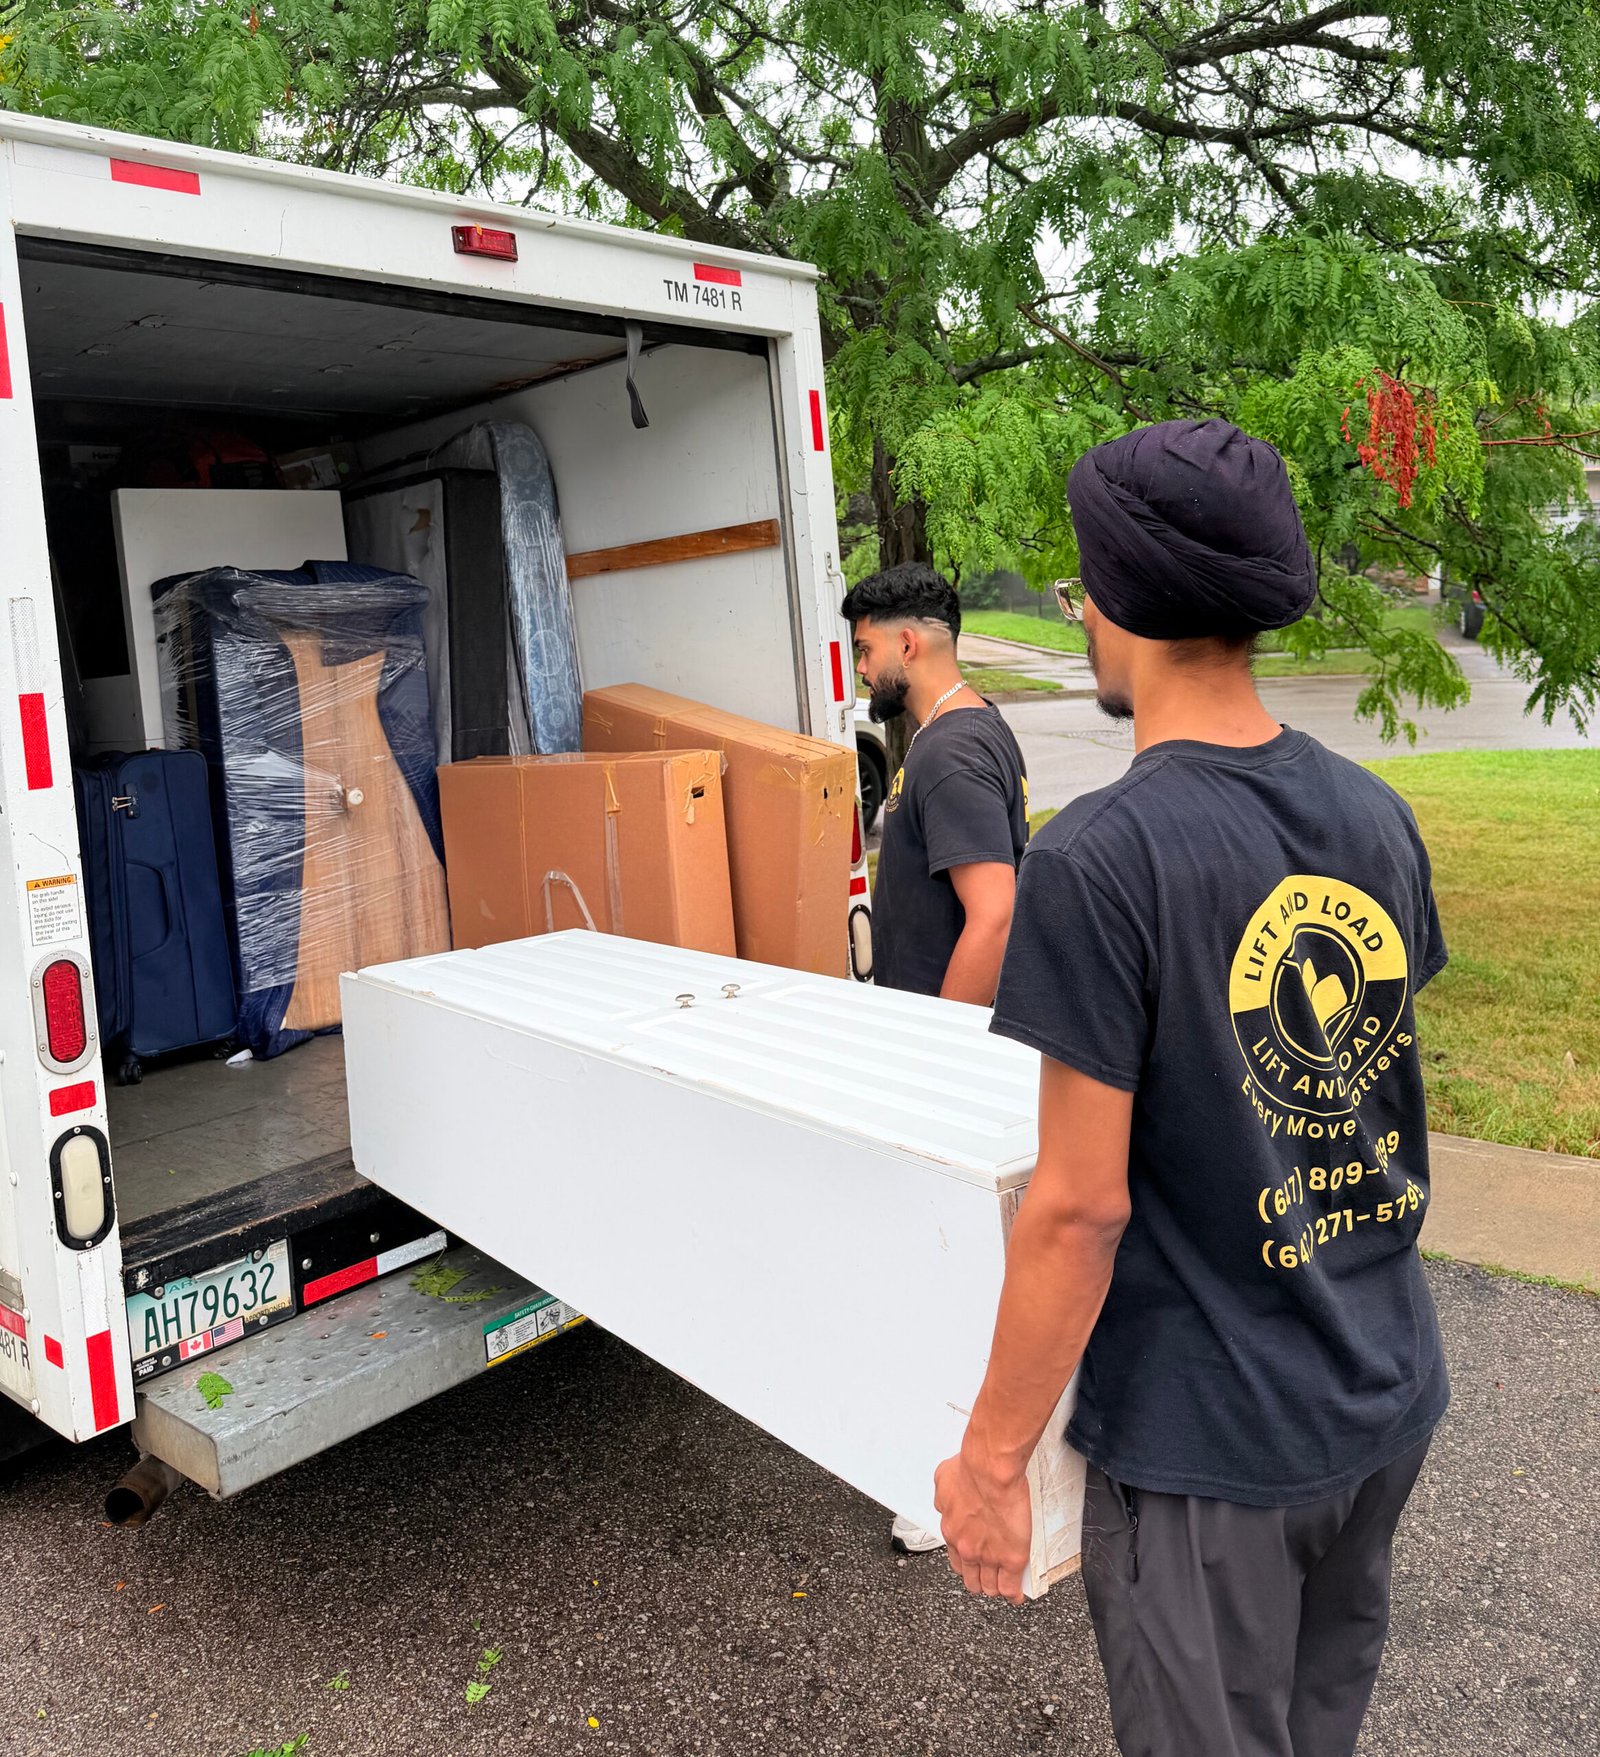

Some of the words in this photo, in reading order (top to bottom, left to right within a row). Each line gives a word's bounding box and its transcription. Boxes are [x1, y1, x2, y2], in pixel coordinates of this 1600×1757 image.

[663, 279, 688, 303] TM
[692, 284, 726, 309] 7481
[731, 291, 742, 312] R
[42, 877, 72, 887] WARNING
[1244, 920, 1278, 982] LIFT
[1280, 892, 1308, 925] AND
[1321, 895, 1383, 952] LOAD
[1241, 1073, 1284, 1138] Every
[1286, 1114, 1357, 1140] Move
[1351, 1032, 1413, 1107] atters
[1251, 1036, 1291, 1083] LIFT
[1292, 1074, 1347, 1100] AND
[1337, 1016, 1381, 1072] OAD
[144, 1262, 278, 1354] AH79632
[20, 1340, 31, 1371] R
[138, 1365, 154, 1377] PAID
